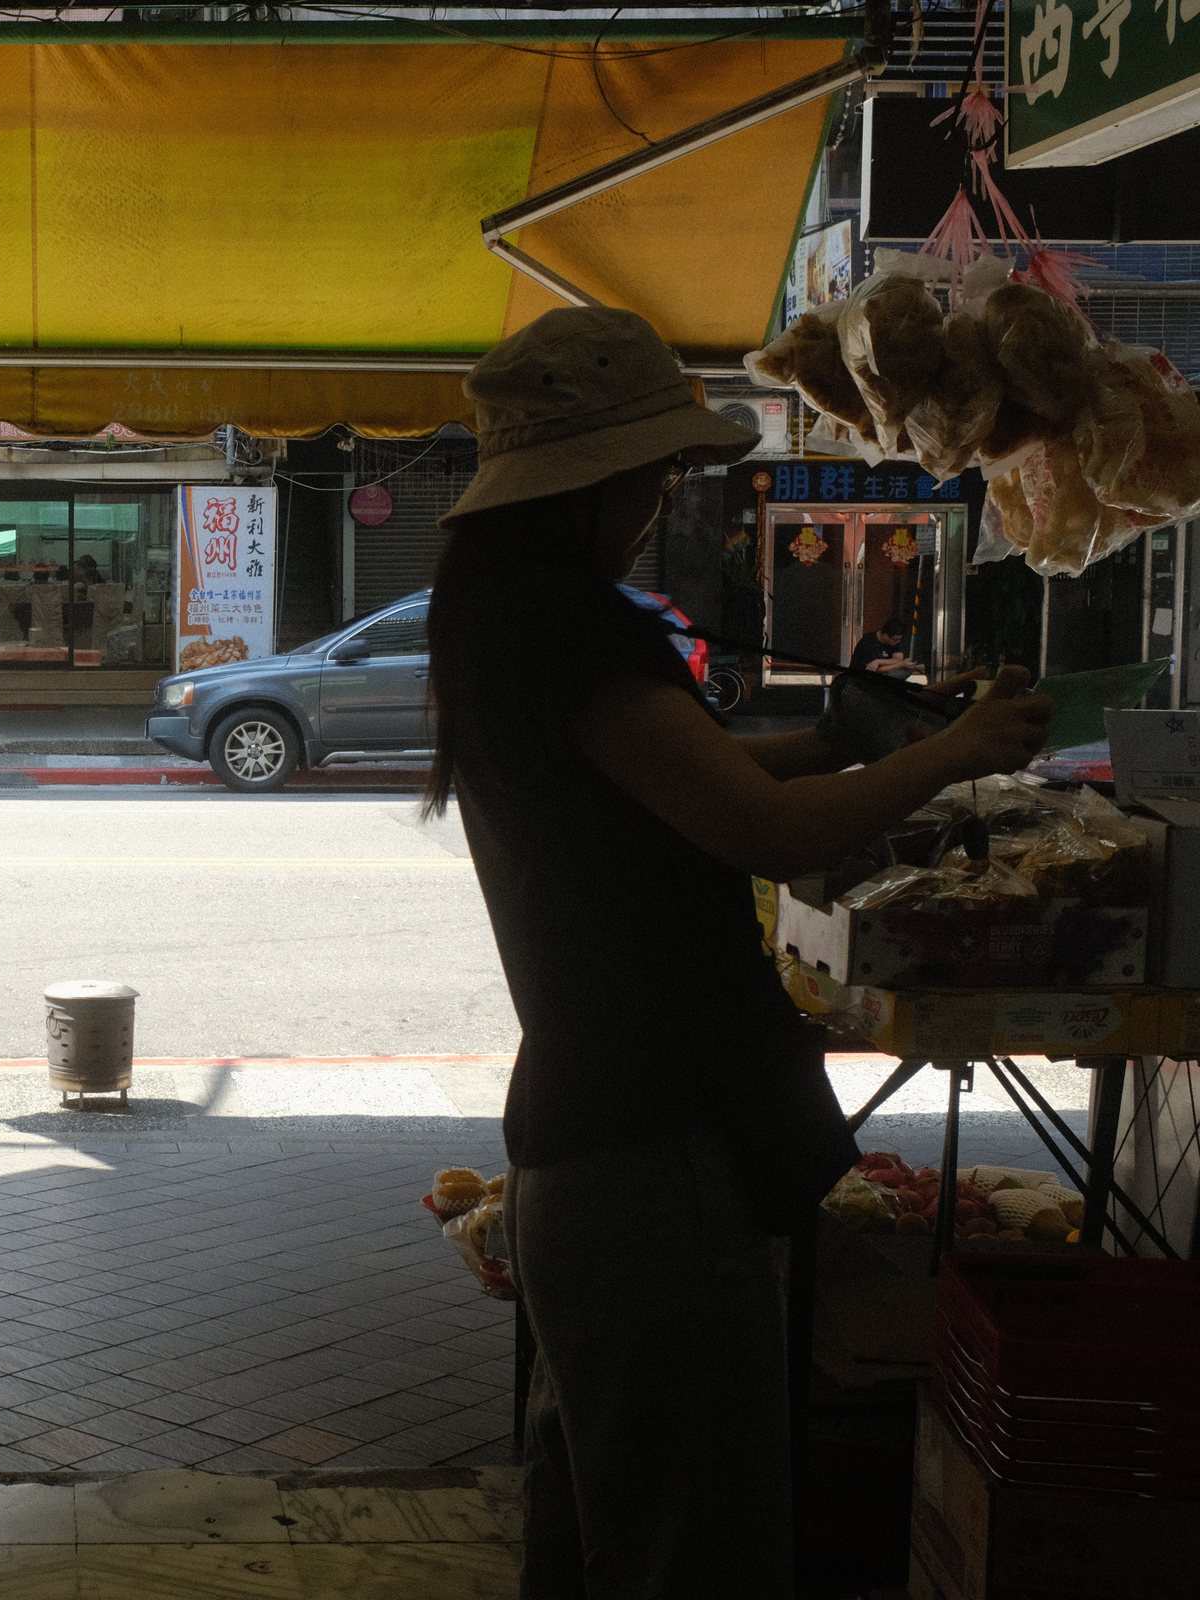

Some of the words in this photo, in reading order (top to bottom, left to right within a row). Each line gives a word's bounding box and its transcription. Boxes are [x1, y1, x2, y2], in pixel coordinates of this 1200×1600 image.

[203, 497, 240, 571] 福州
[246, 494, 265, 578] 新利大雅
